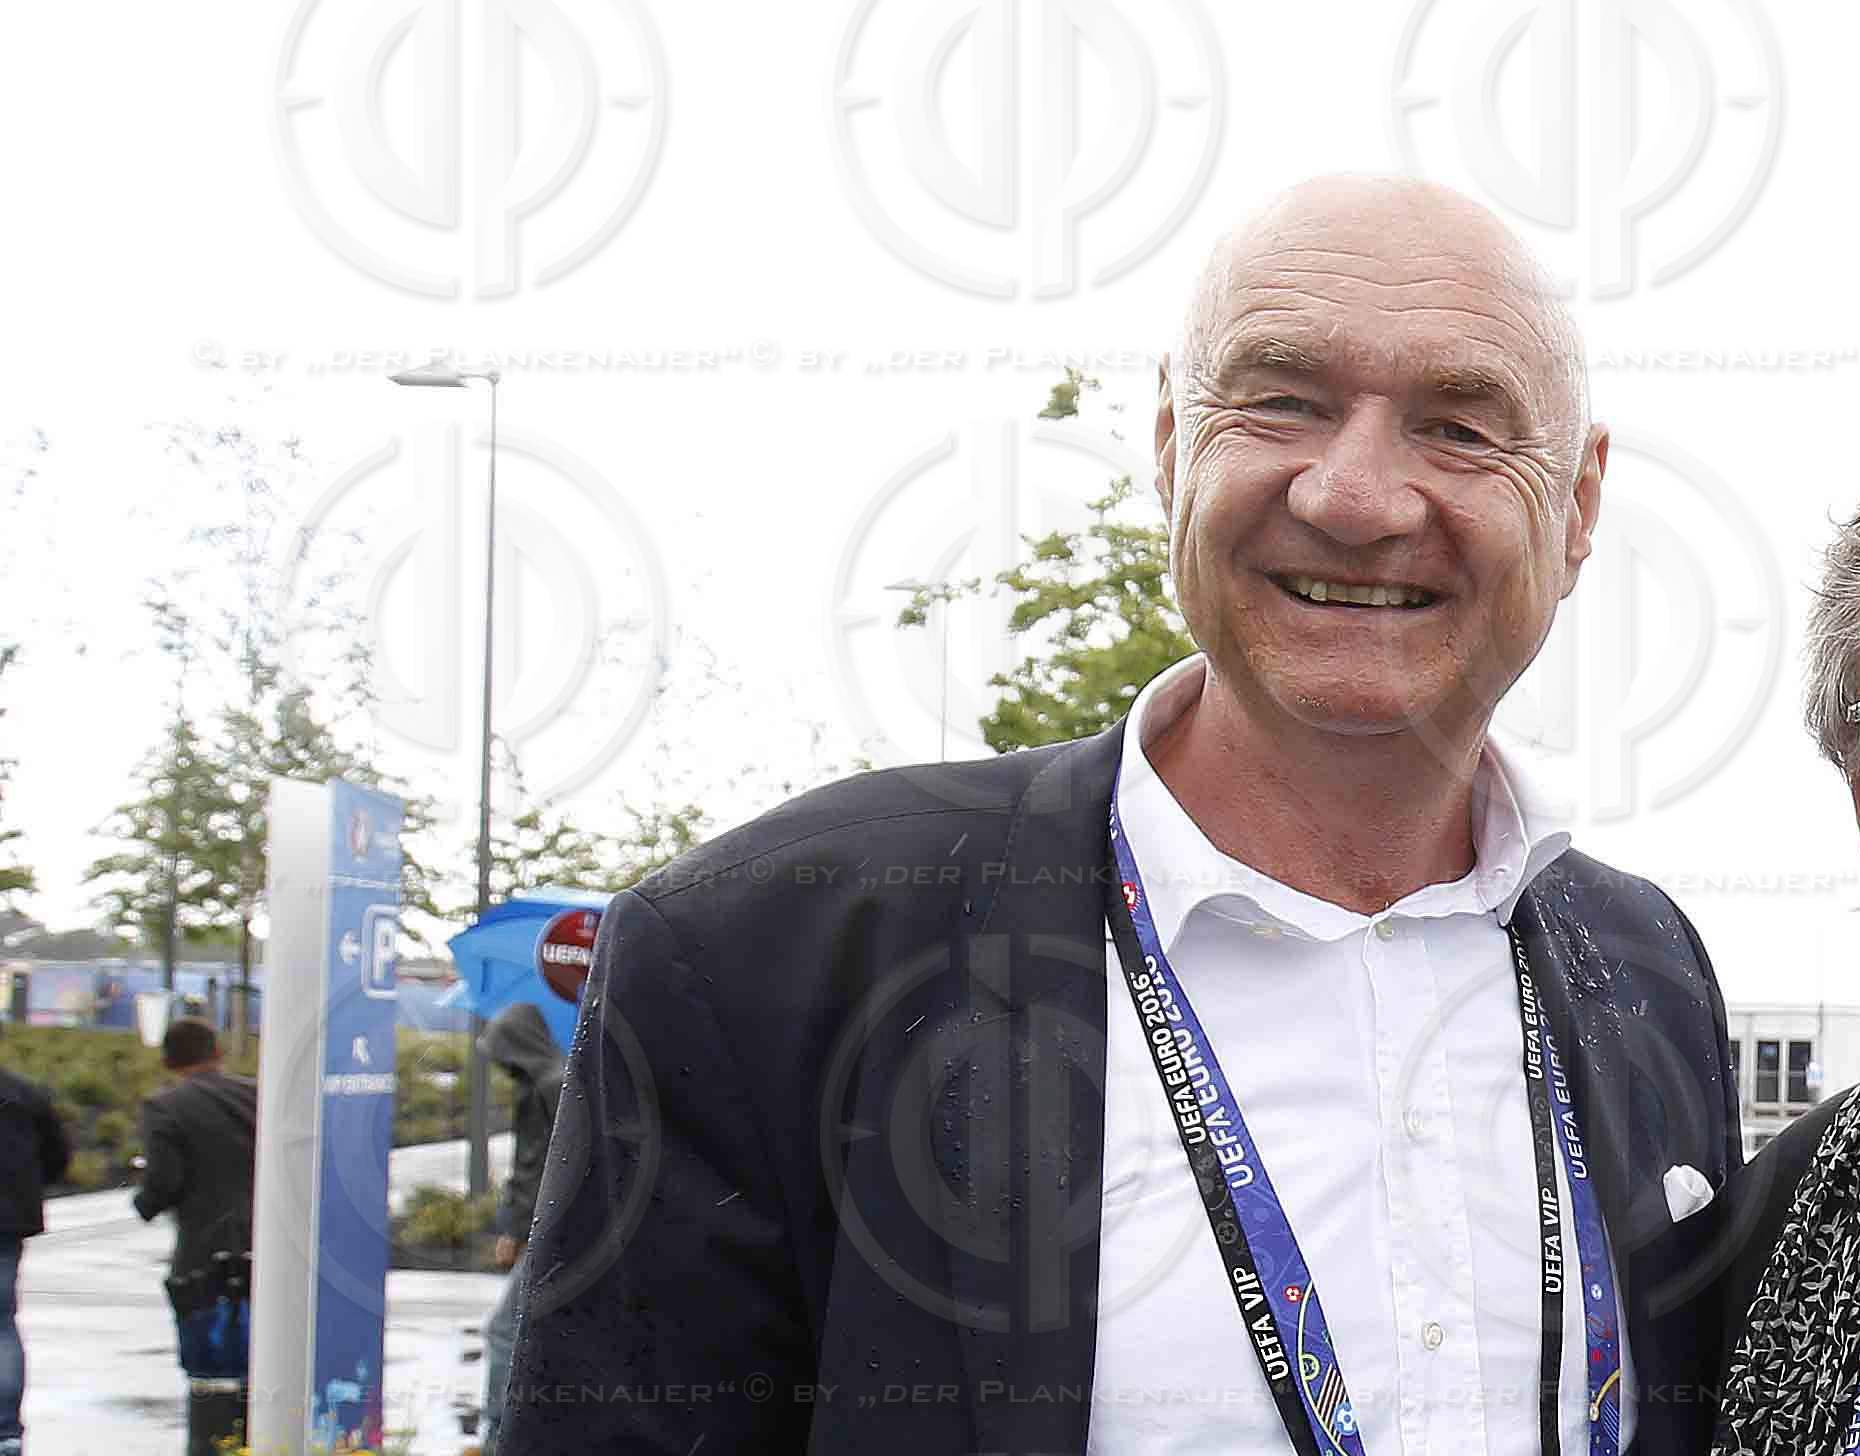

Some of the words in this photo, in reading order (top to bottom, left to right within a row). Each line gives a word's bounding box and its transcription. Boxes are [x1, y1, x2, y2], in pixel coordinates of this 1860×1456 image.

[1519, 973, 1540, 1028] EURO
[1151, 1026, 1191, 1089] EURO
[1527, 1029, 1543, 1080] UEFA
[1173, 1088, 1207, 1145] UEFA
[1561, 1110, 1589, 1180] UEFA
[1205, 1105, 1254, 1190] UEFA
[1541, 1186, 1560, 1231] VIP
[1232, 1266, 1264, 1312] VIP
[1545, 1233, 1563, 1295] UEFA
[1252, 1313, 1290, 1381] UEFA
